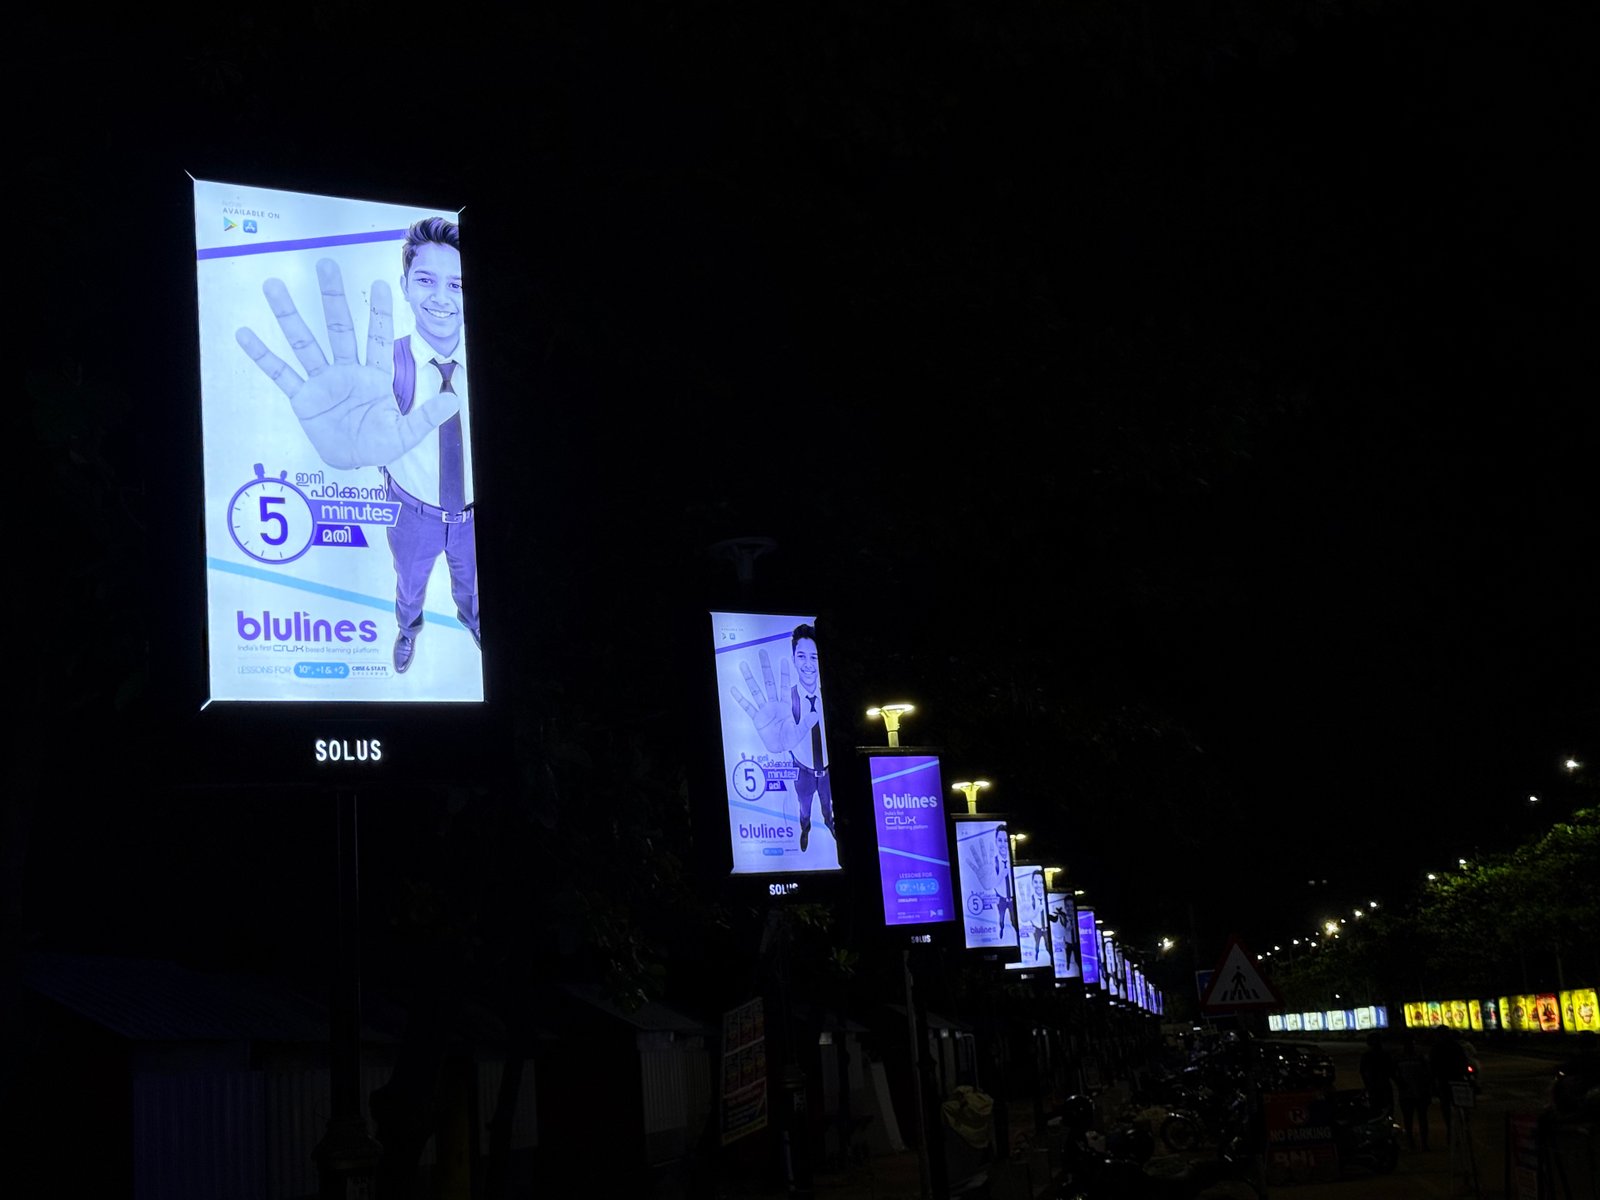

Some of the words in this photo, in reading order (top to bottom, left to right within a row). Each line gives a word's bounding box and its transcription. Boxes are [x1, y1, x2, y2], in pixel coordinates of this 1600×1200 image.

[223, 207, 265, 218] AVAILABLE
[295, 470, 324, 487] ഇനി
[321, 501, 394, 522] minutes
[259, 496, 289, 546] 5
[322, 525, 352, 543] മതി
[236, 610, 378, 643] blulines
[237, 666, 273, 675] LESSONS
[274, 666, 292, 675] FOR
[333, 666, 345, 675] +2
[314, 738, 383, 762] SOLUS
[744, 768, 756, 793] 5
[767, 769, 797, 779] minutes
[882, 793, 938, 809] blulines
[739, 823, 794, 840] blulines
[972, 898, 980, 911] 5
[911, 934, 931, 944] SOLUS
